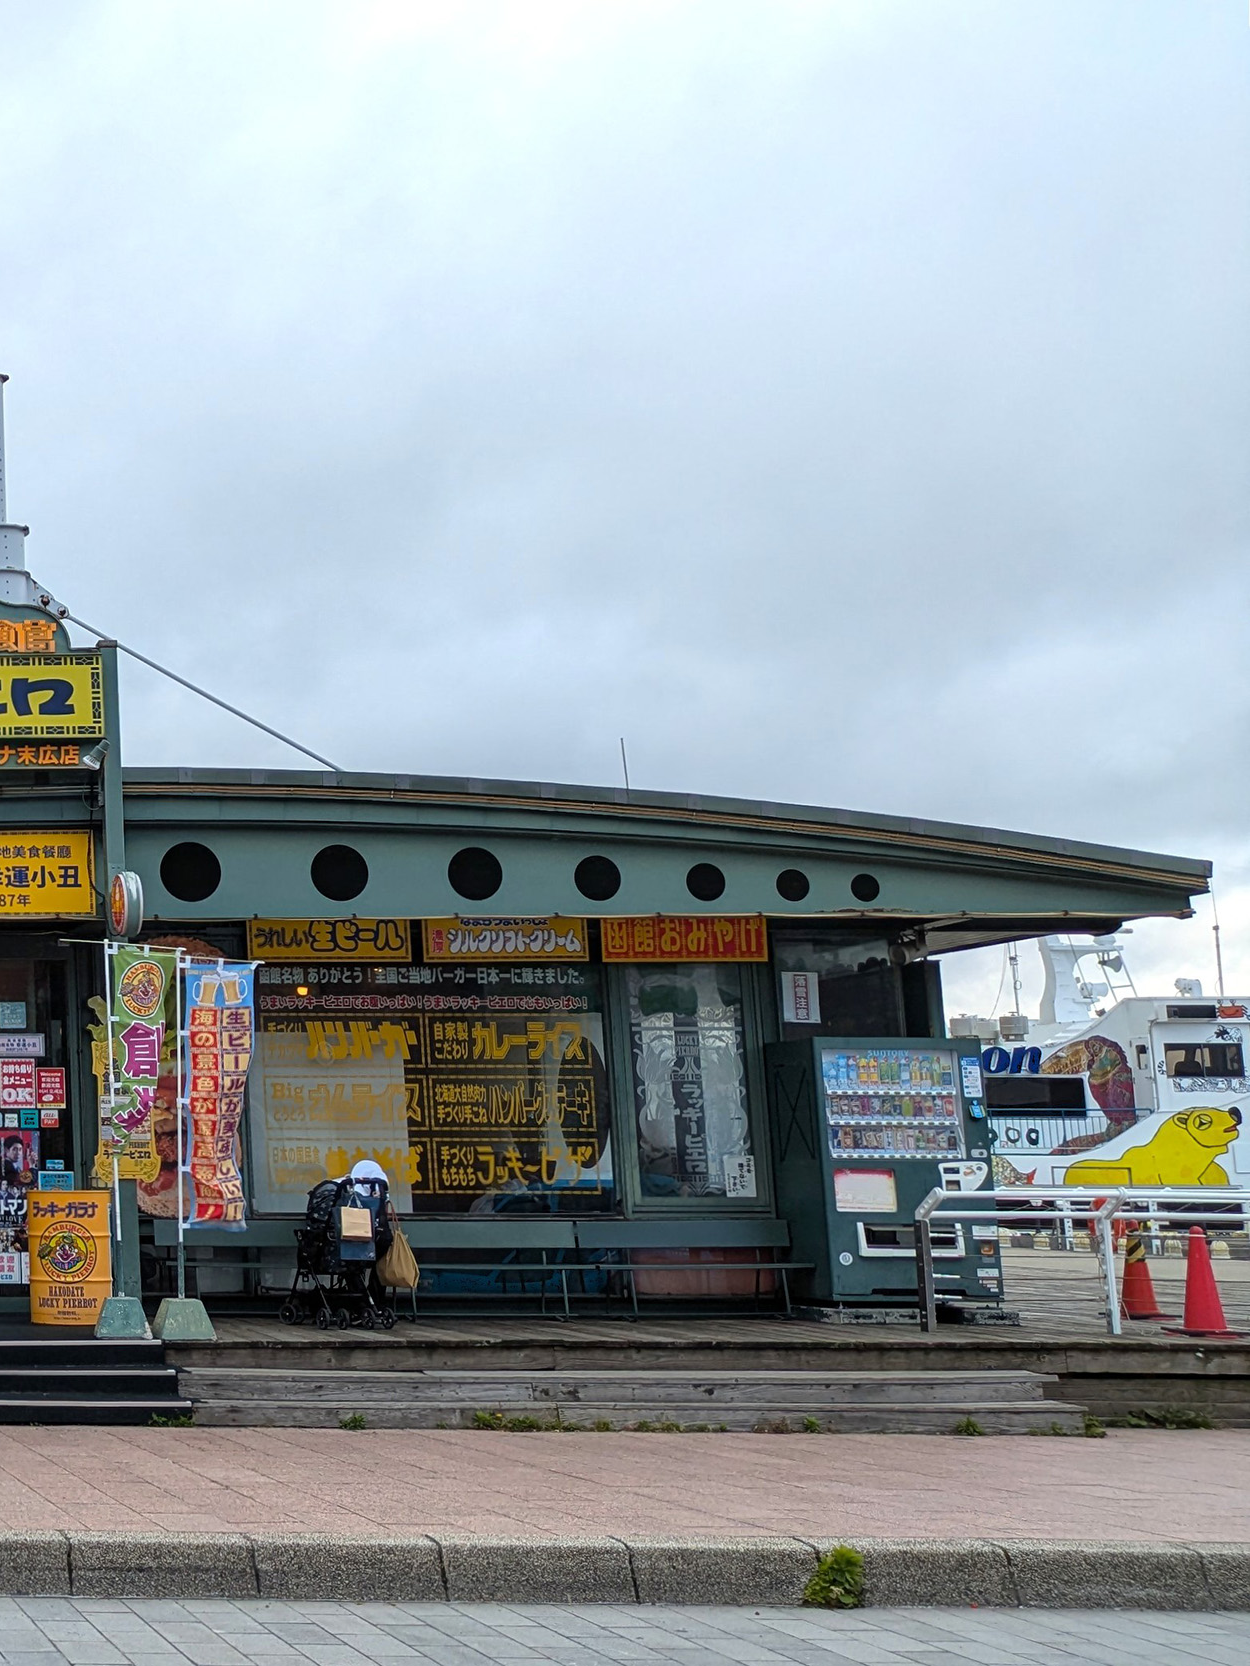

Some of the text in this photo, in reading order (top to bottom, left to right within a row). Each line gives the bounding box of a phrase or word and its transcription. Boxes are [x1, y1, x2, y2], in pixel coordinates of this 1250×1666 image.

[253, 920, 404, 953] うれしい生ビール
[446, 928, 582, 954] シルクソフトクリーム
[607, 918, 760, 953] 函館おみやげ
[259, 967, 304, 984] 函館名物
[795, 975, 809, 1020] 落雪注意
[433, 1021, 586, 1060] 自家製 カレーライス
[434, 1042, 469, 1060] こだわり
[867, 1050, 910, 1058] SUNTORY
[3, 1075, 32, 1085] 全メニュー
[3, 1088, 33, 1103] OK
[680, 1083, 708, 1174] ラッキーピエロ
[441, 1146, 474, 1165] 手づくり
[442, 1167, 476, 1187] もちもち
[33, 1202, 99, 1218] ラッキーガラナ
[44, 1224, 92, 1243] HAMBURGER
[44, 1251, 95, 1281] LUCKY PIERROT
[48, 1286, 85, 1297] HAKODATE
[39, 1297, 98, 1309] LUCKY PIERROT
